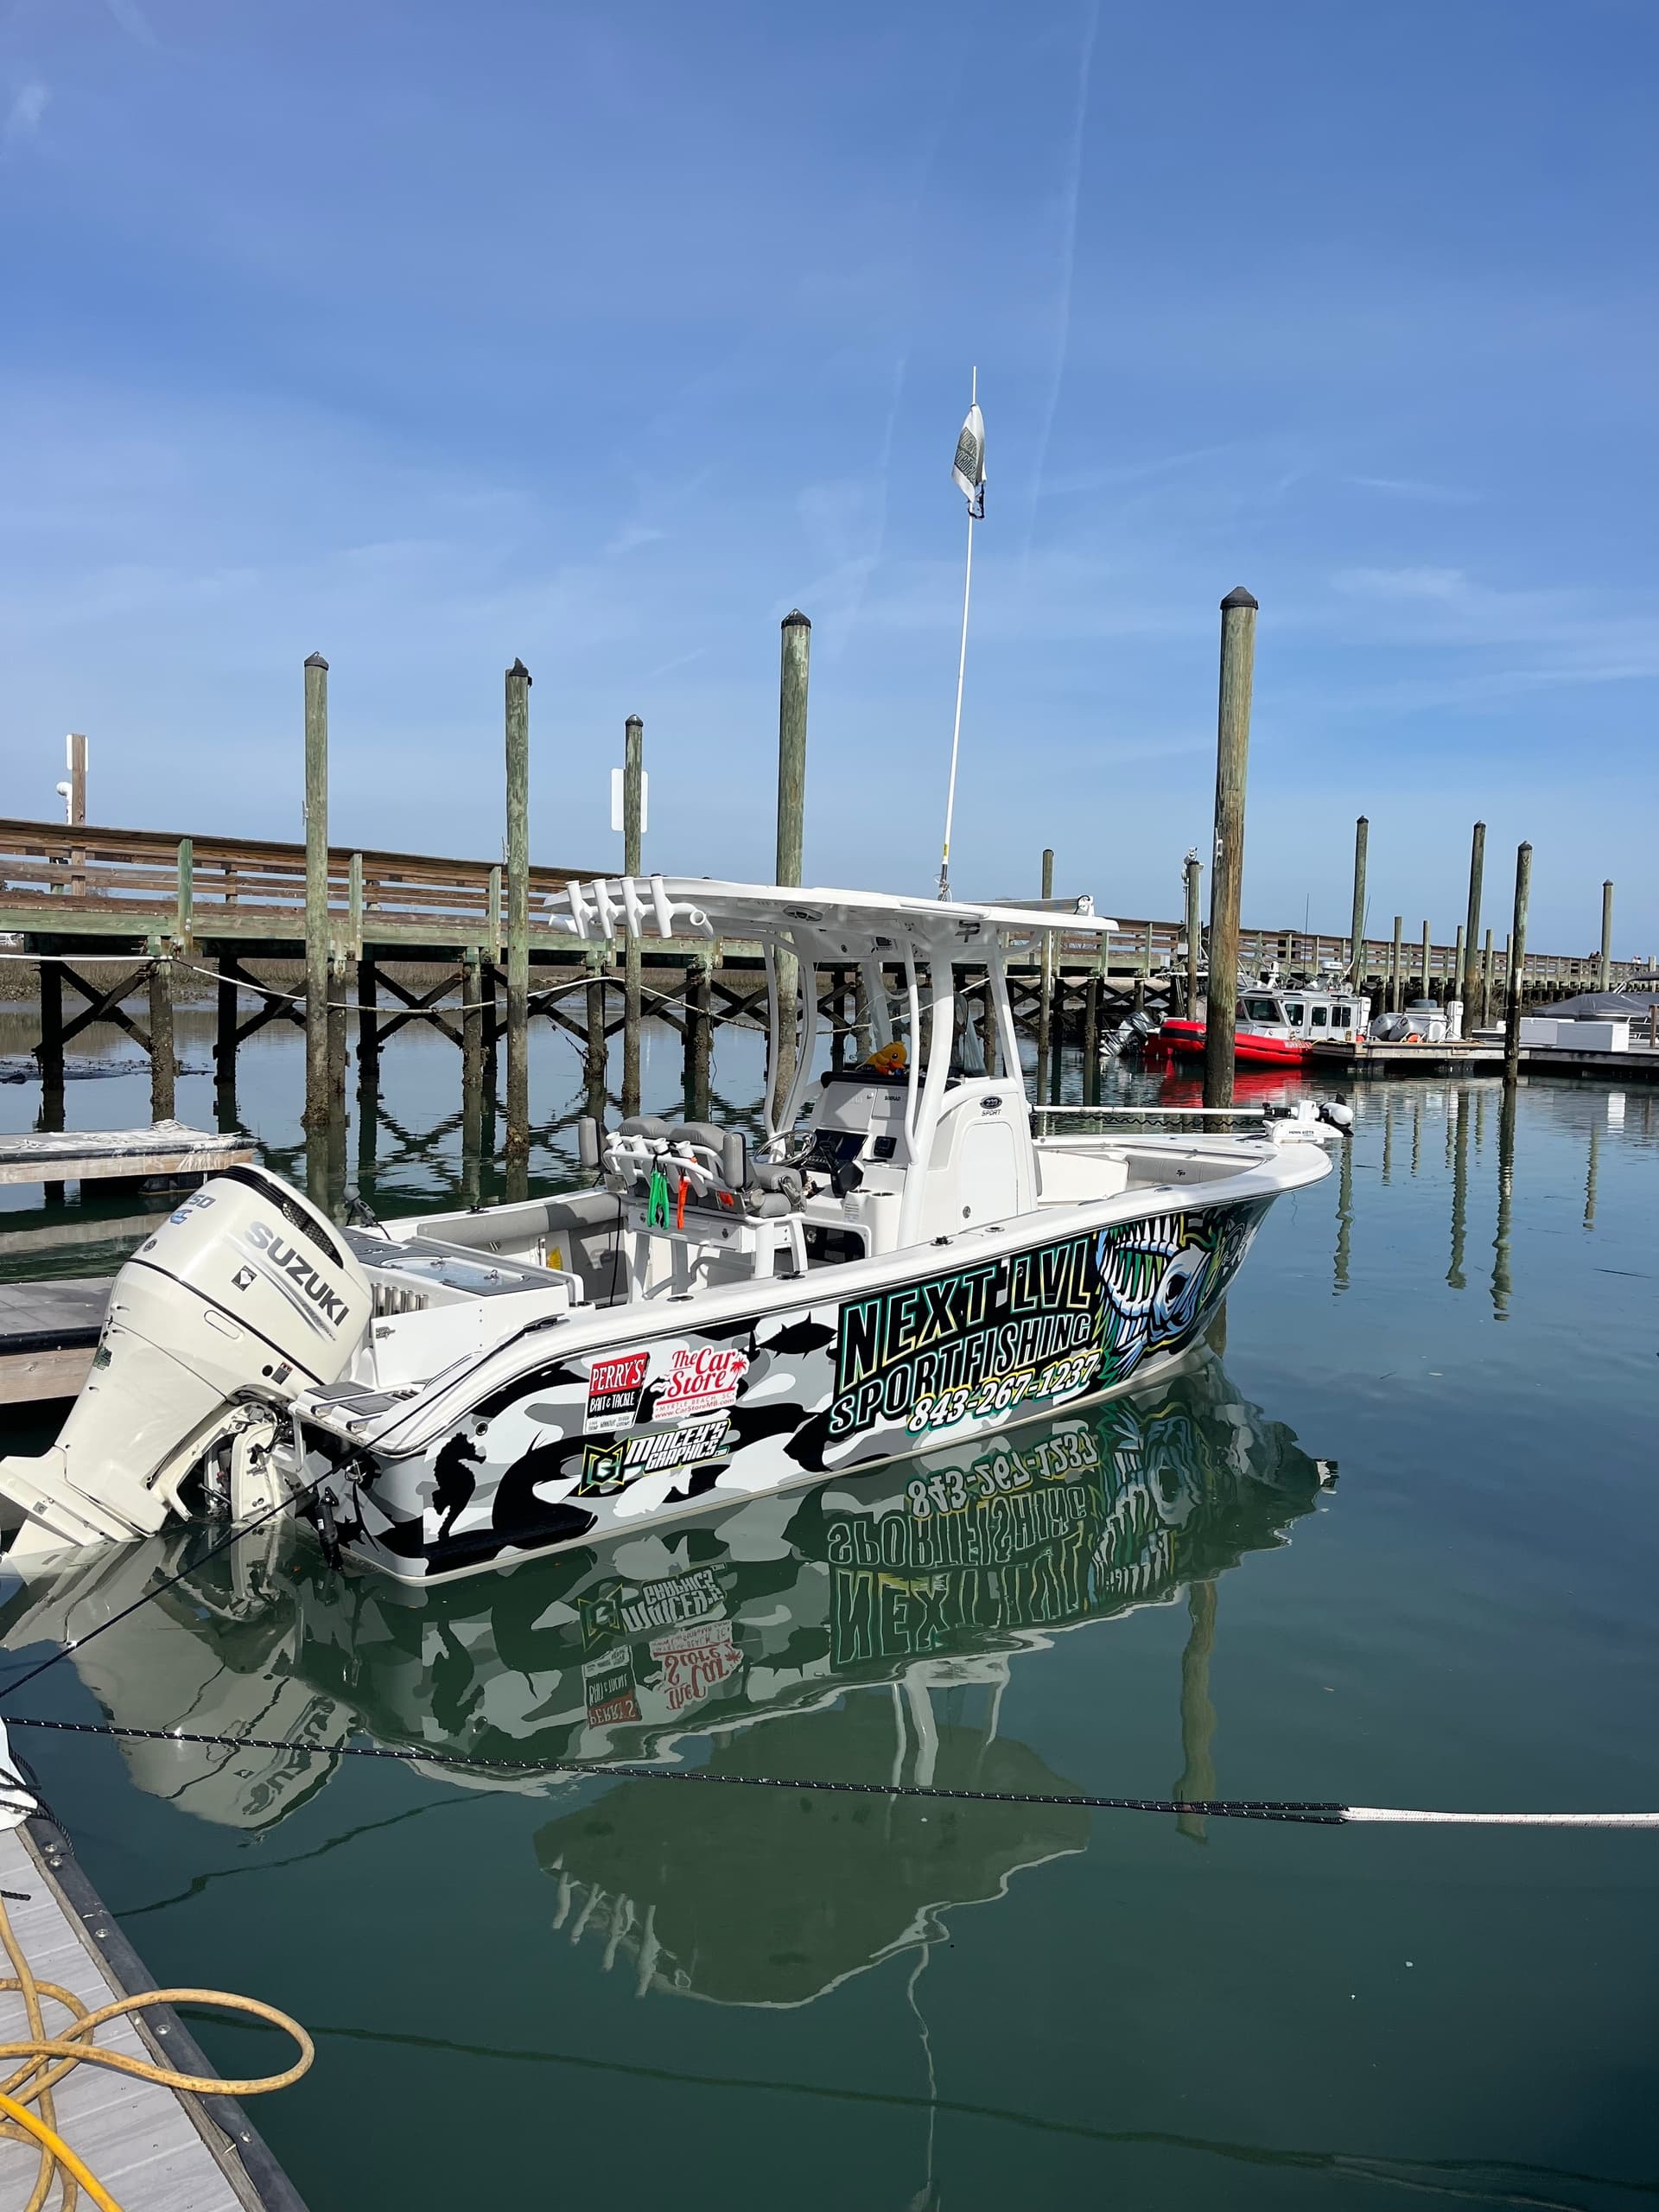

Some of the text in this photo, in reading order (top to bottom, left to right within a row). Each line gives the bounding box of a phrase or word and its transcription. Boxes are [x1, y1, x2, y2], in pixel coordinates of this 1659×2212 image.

[186, 1193, 216, 1209] 50
[244, 1221, 350, 1326] SUZUKI
[838, 1265, 996, 1395] NEXT
[1010, 1236, 1091, 1314] LVL
[590, 1358, 645, 1392] PERRY'S
[671, 1348, 736, 1375] The Car
[828, 1313, 1092, 1436] SPORTFISHING
[589, 1391, 636, 1413] BAIT & TACKLE
[667, 1370, 727, 1398] Store
[907, 1351, 1100, 1433] 843-267-1237
[623, 1420, 728, 1466] MINCEY'S
